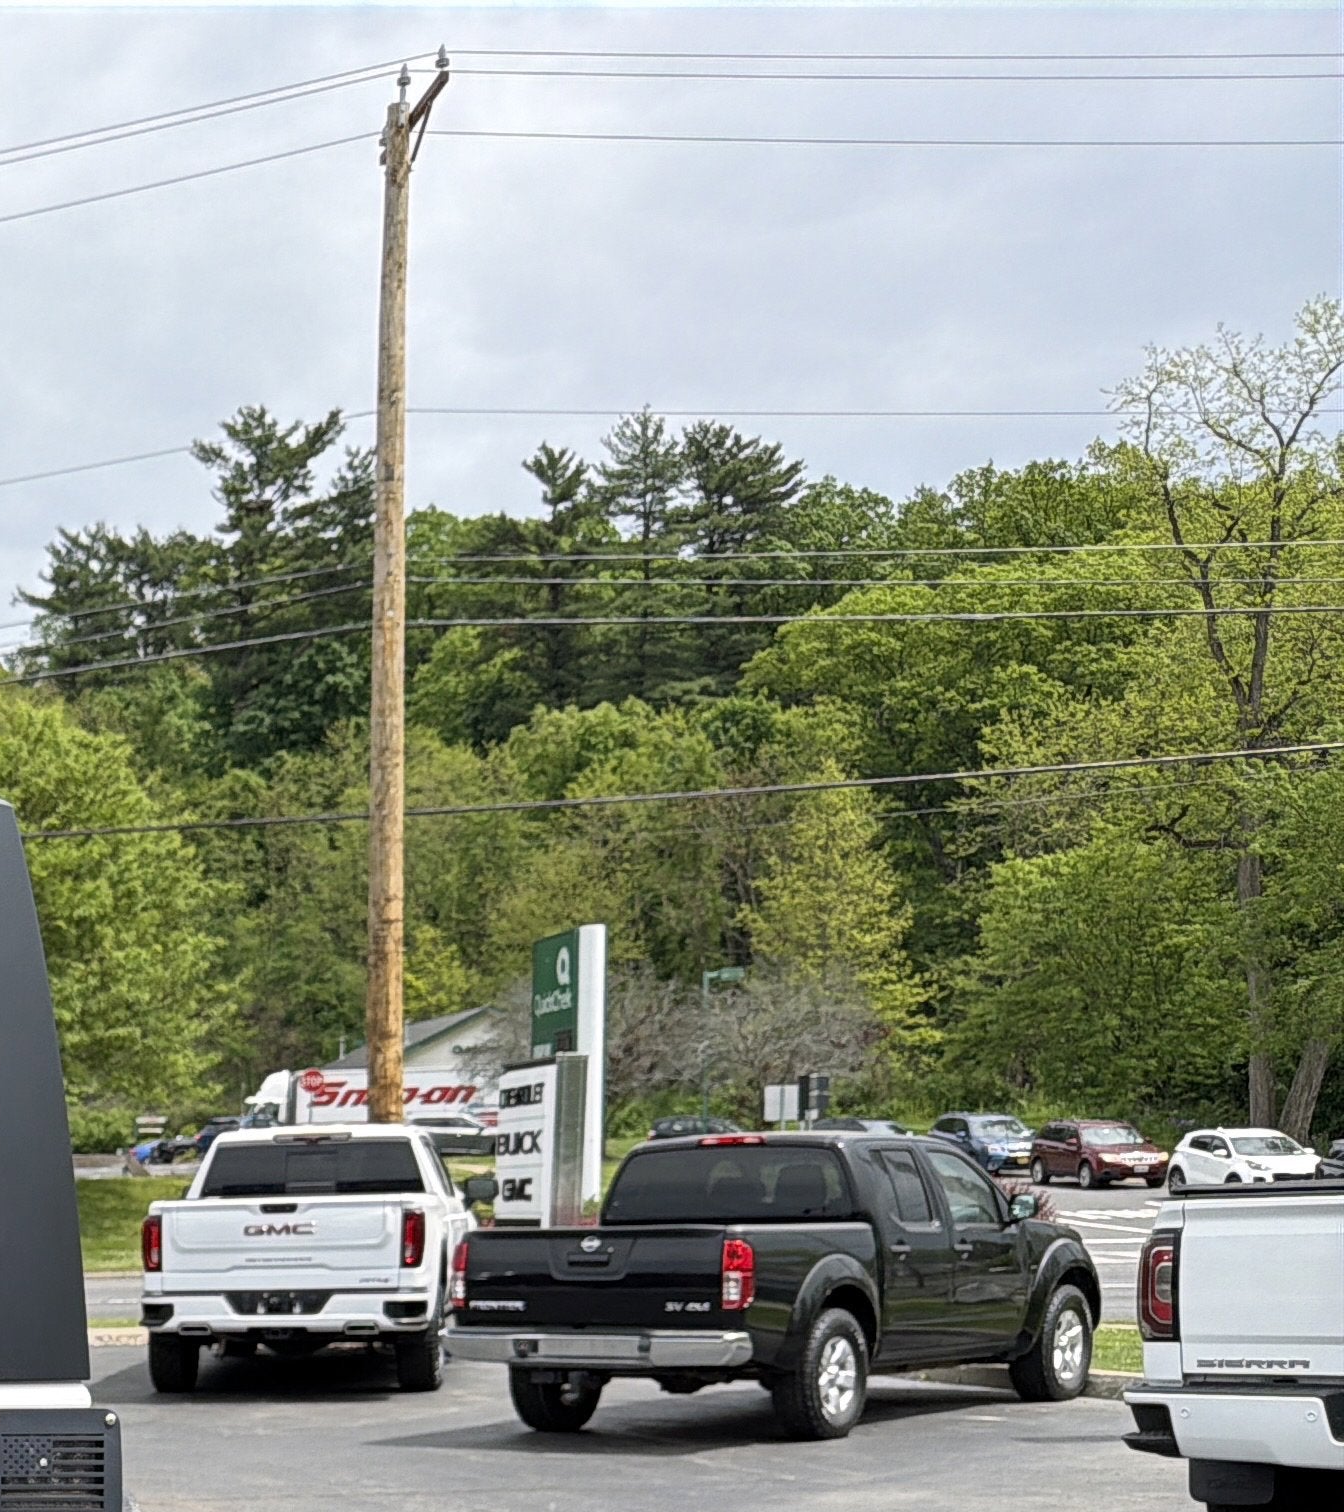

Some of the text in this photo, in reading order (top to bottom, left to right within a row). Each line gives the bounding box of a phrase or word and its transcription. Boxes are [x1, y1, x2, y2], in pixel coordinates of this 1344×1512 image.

[496, 1129, 543, 1156] BUICK
[244, 1223, 315, 1236] GMC
[1196, 1358, 1311, 1369] SIERRA
